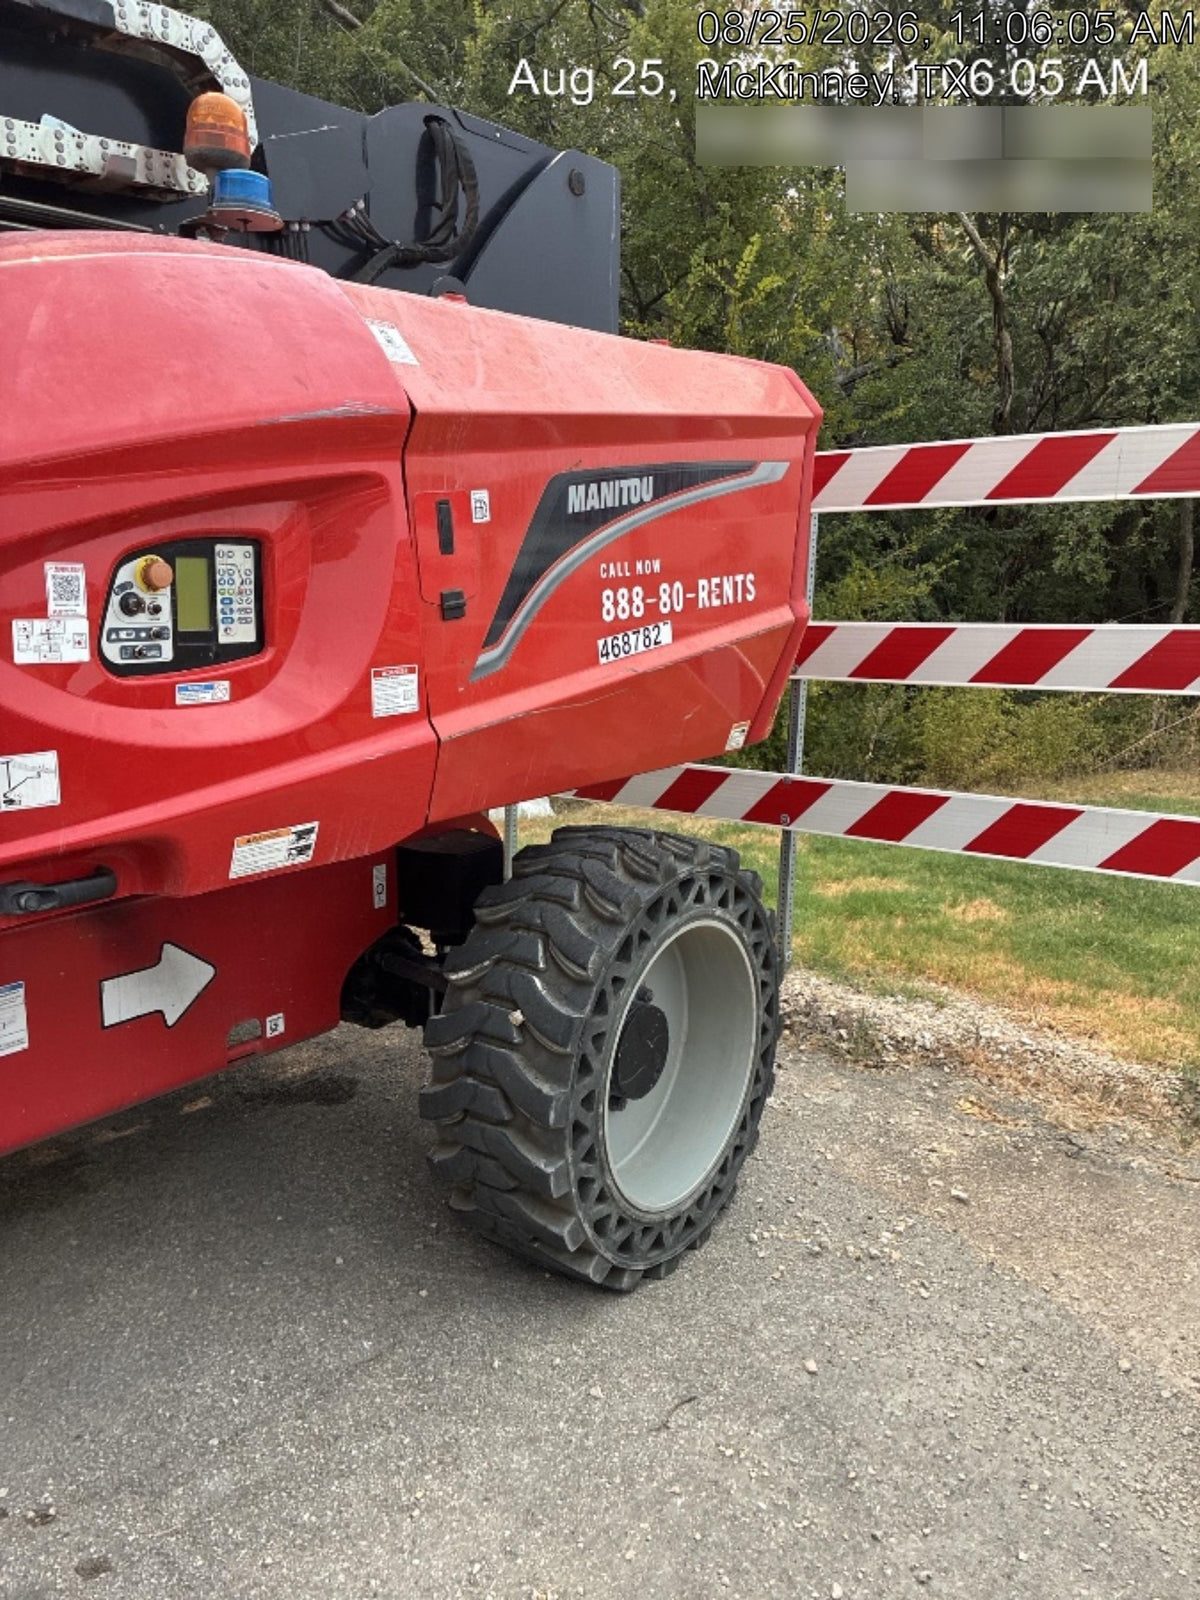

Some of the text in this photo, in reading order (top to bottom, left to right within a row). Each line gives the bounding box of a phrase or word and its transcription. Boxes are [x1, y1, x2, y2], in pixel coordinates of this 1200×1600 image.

[567, 476, 654, 514] MANITOU
[600, 559, 661, 578] CALL NOW
[602, 572, 757, 622] 888-80-RENTS
